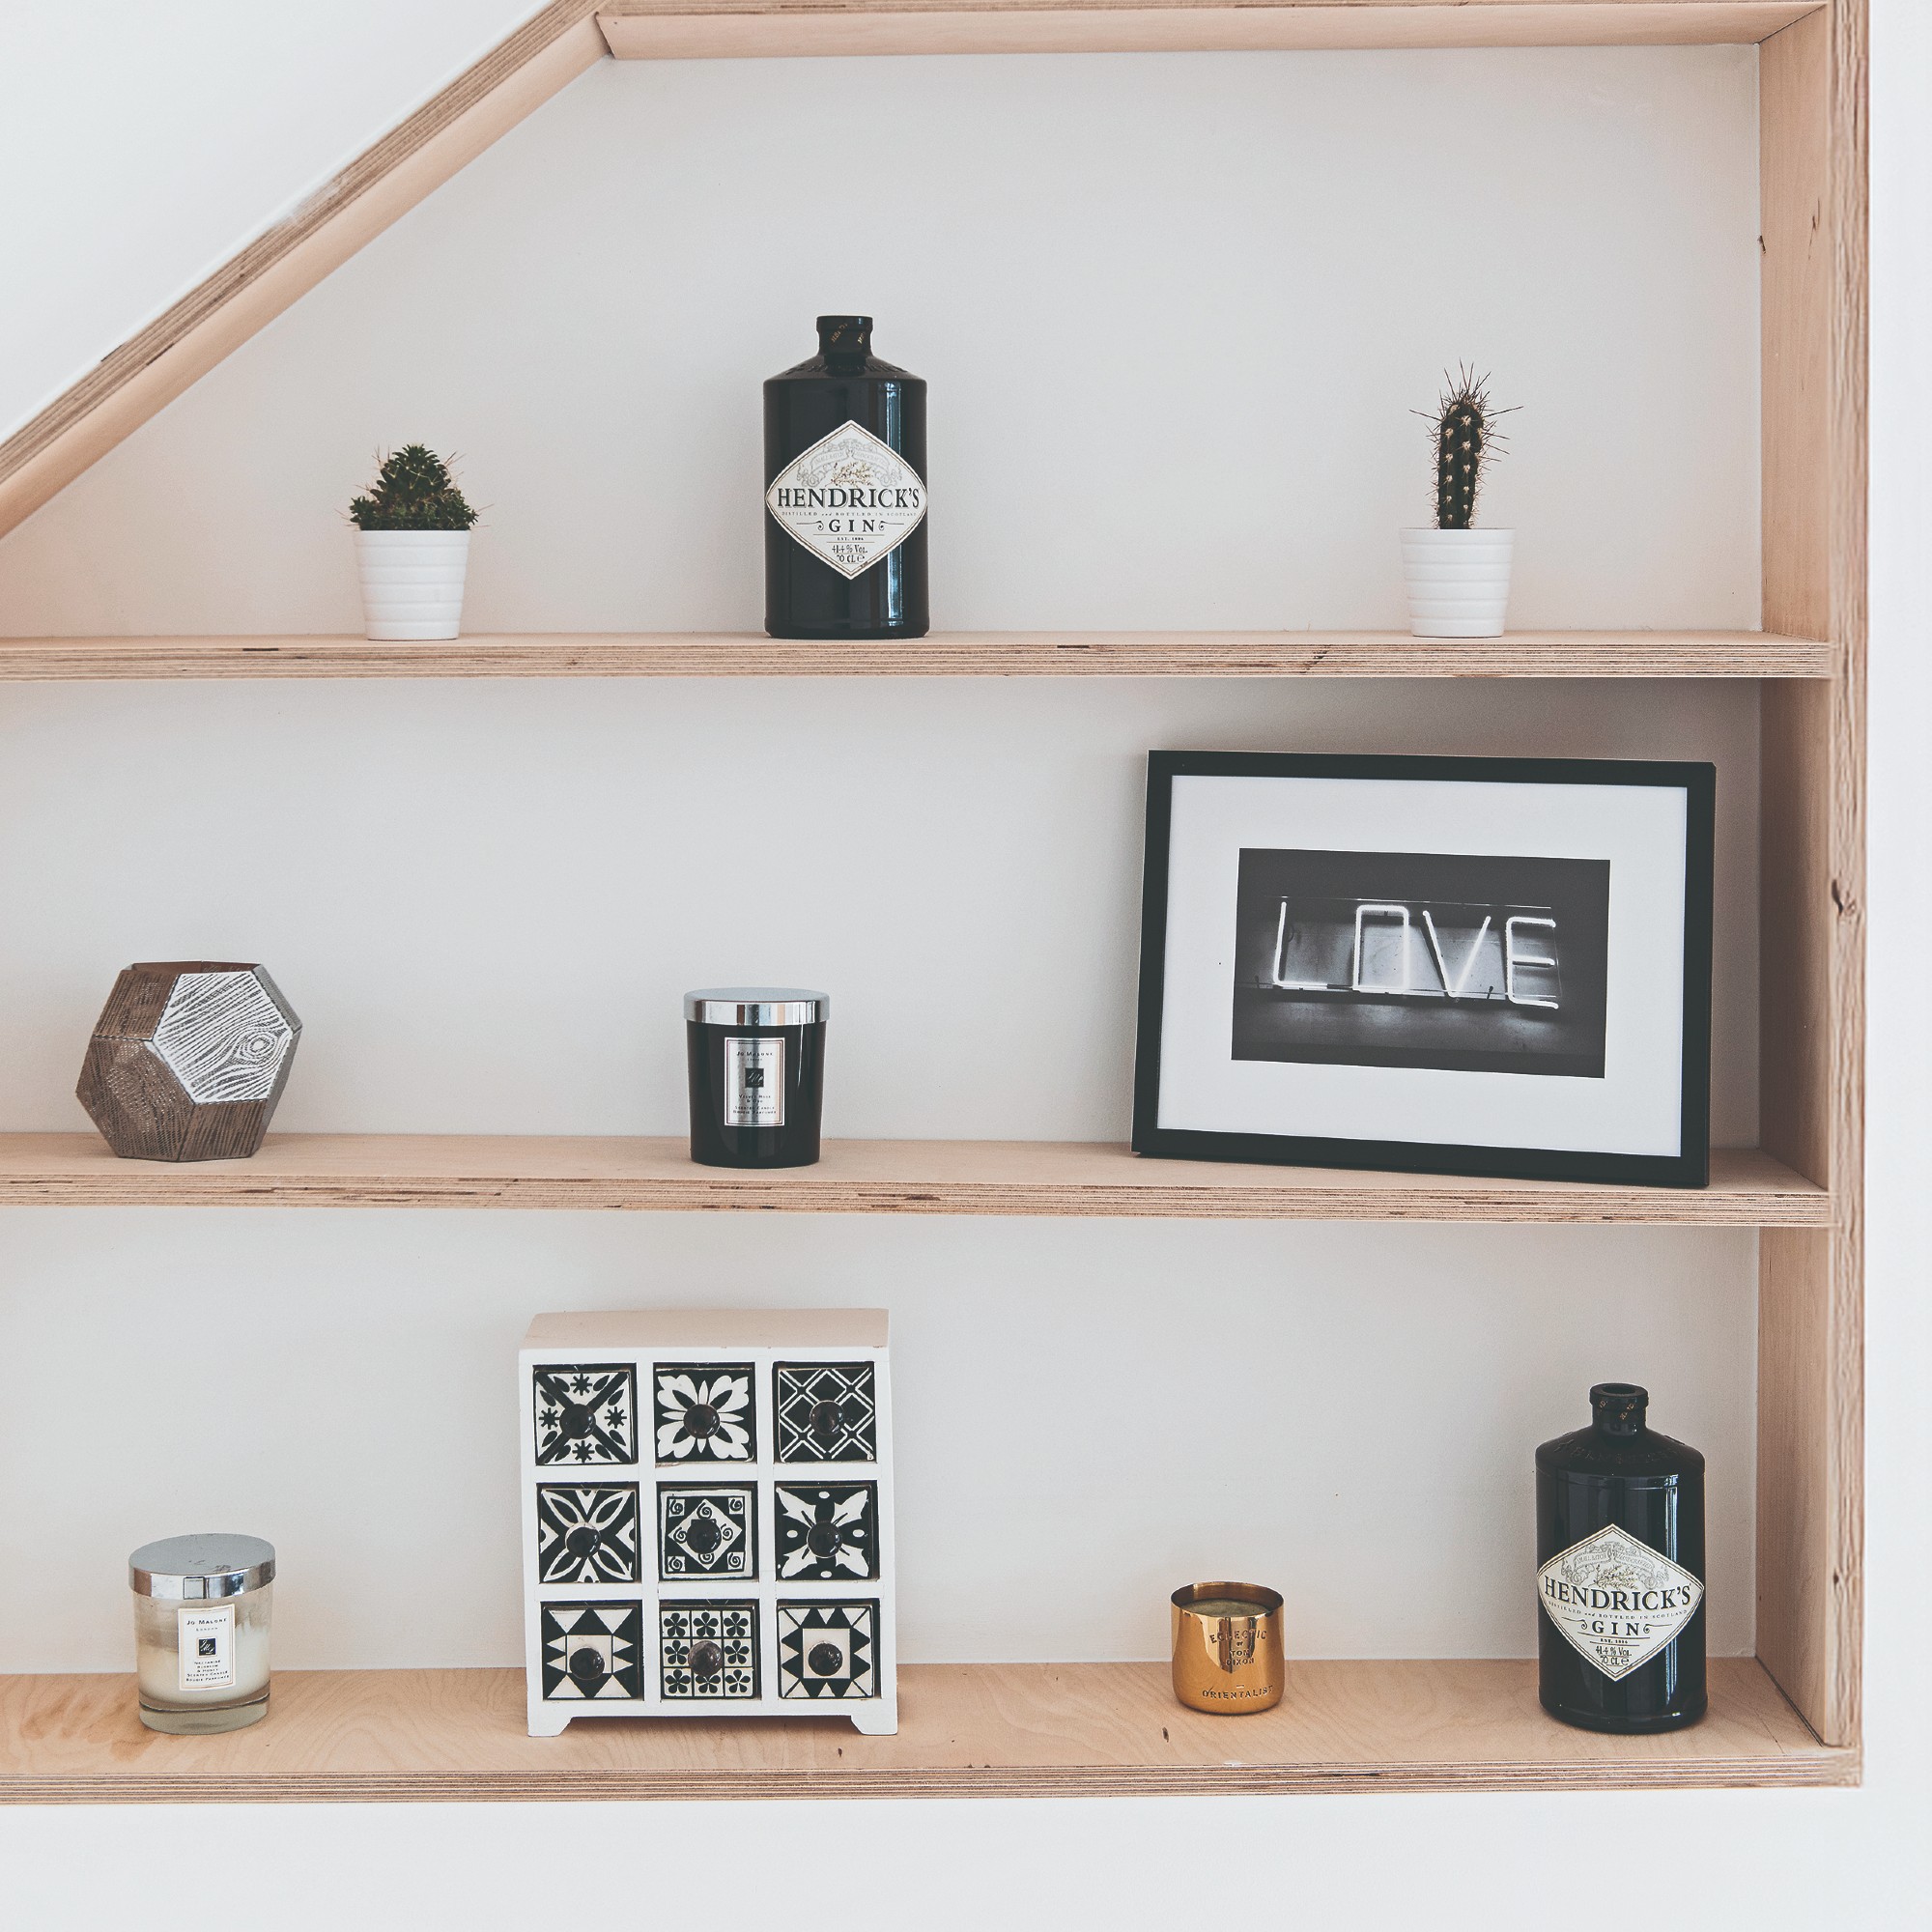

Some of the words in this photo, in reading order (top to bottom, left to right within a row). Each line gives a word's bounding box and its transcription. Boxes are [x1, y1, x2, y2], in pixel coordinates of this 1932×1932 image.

[778, 488, 920, 508] HENDRICK'S
[829, 519, 875, 532] GIN
[1271, 900, 1560, 1011] LOVE
[1545, 1575, 1691, 1611] HENDRICK'S
[1652, 1609, 1688, 1619] SCOTLAND
[1592, 1620, 1639, 1635] GIN
[1209, 1628, 1267, 1644] ECLECTIC
[1226, 1657, 1255, 1666] DIXON
[1202, 1686, 1273, 1700] ORIENTALIST
